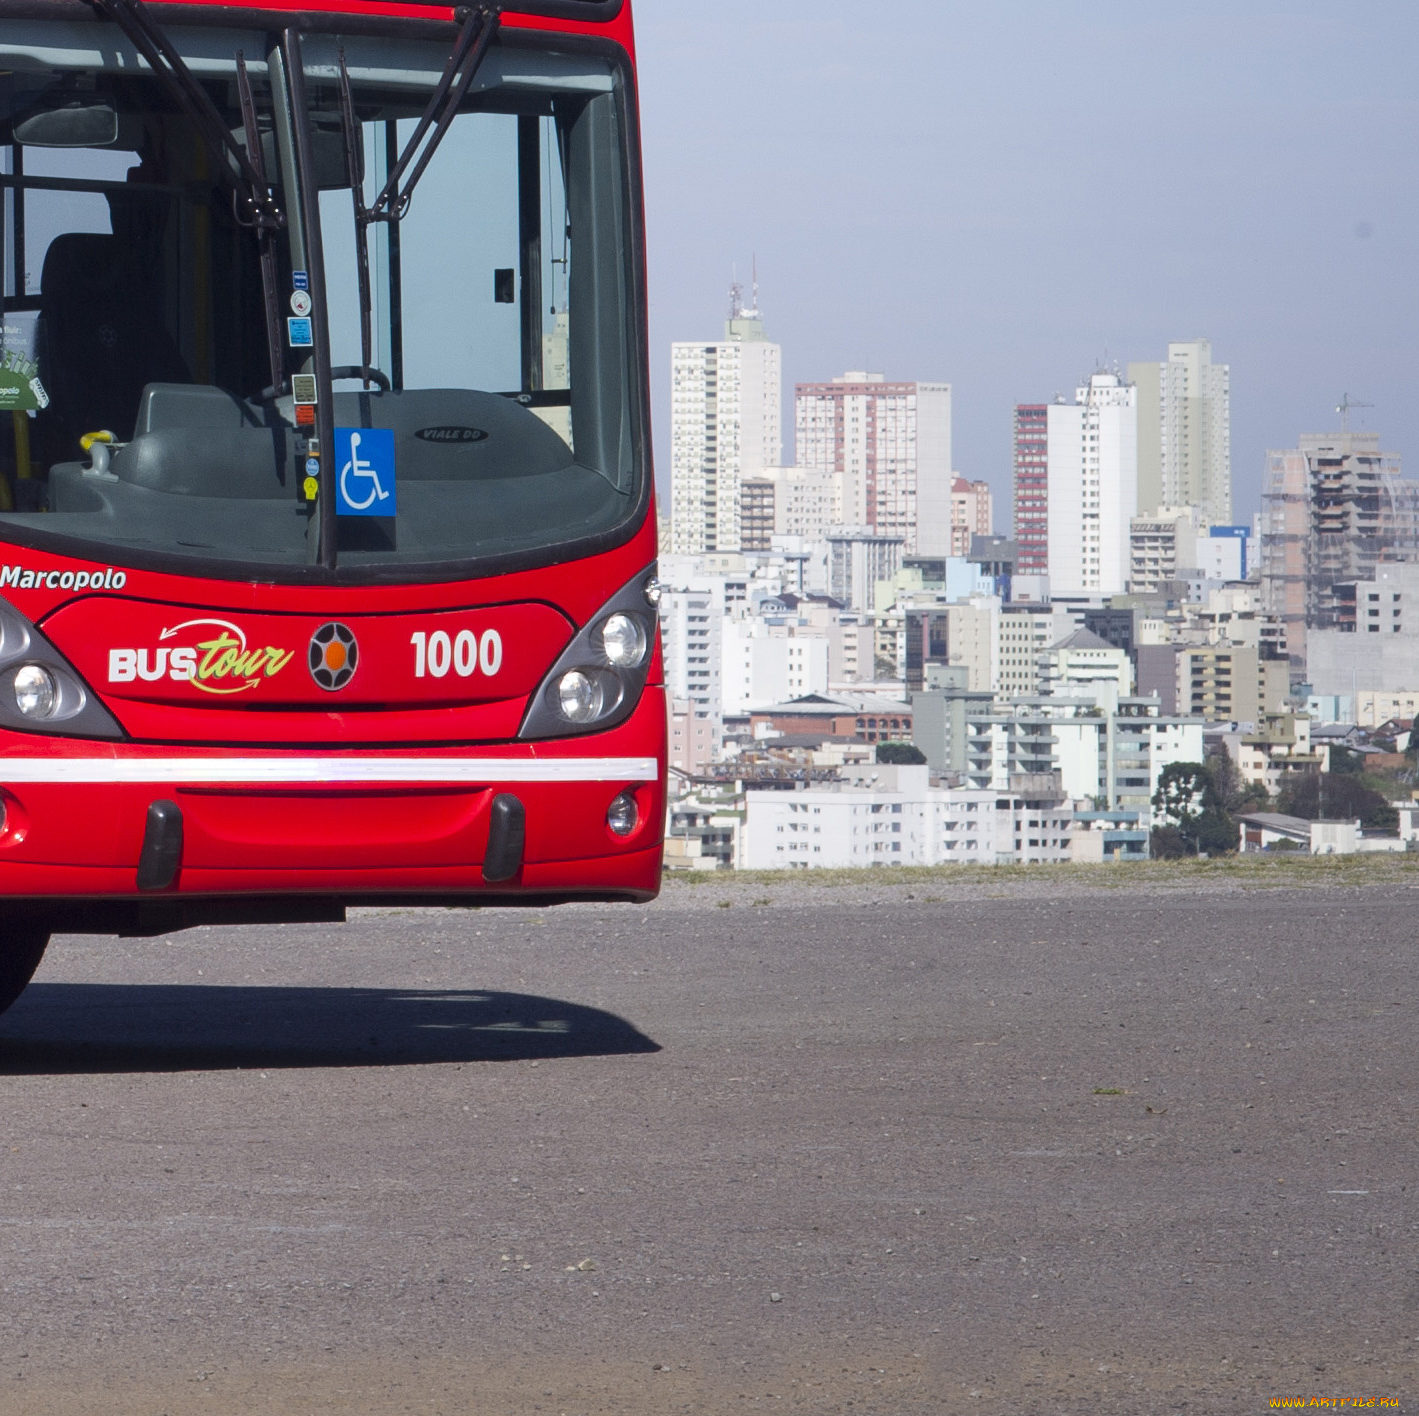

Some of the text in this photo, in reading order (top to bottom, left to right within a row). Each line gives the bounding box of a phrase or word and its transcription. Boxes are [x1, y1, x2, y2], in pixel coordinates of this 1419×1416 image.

[423, 429, 481, 439] VIALE DD
[410, 628, 503, 678] 1000
